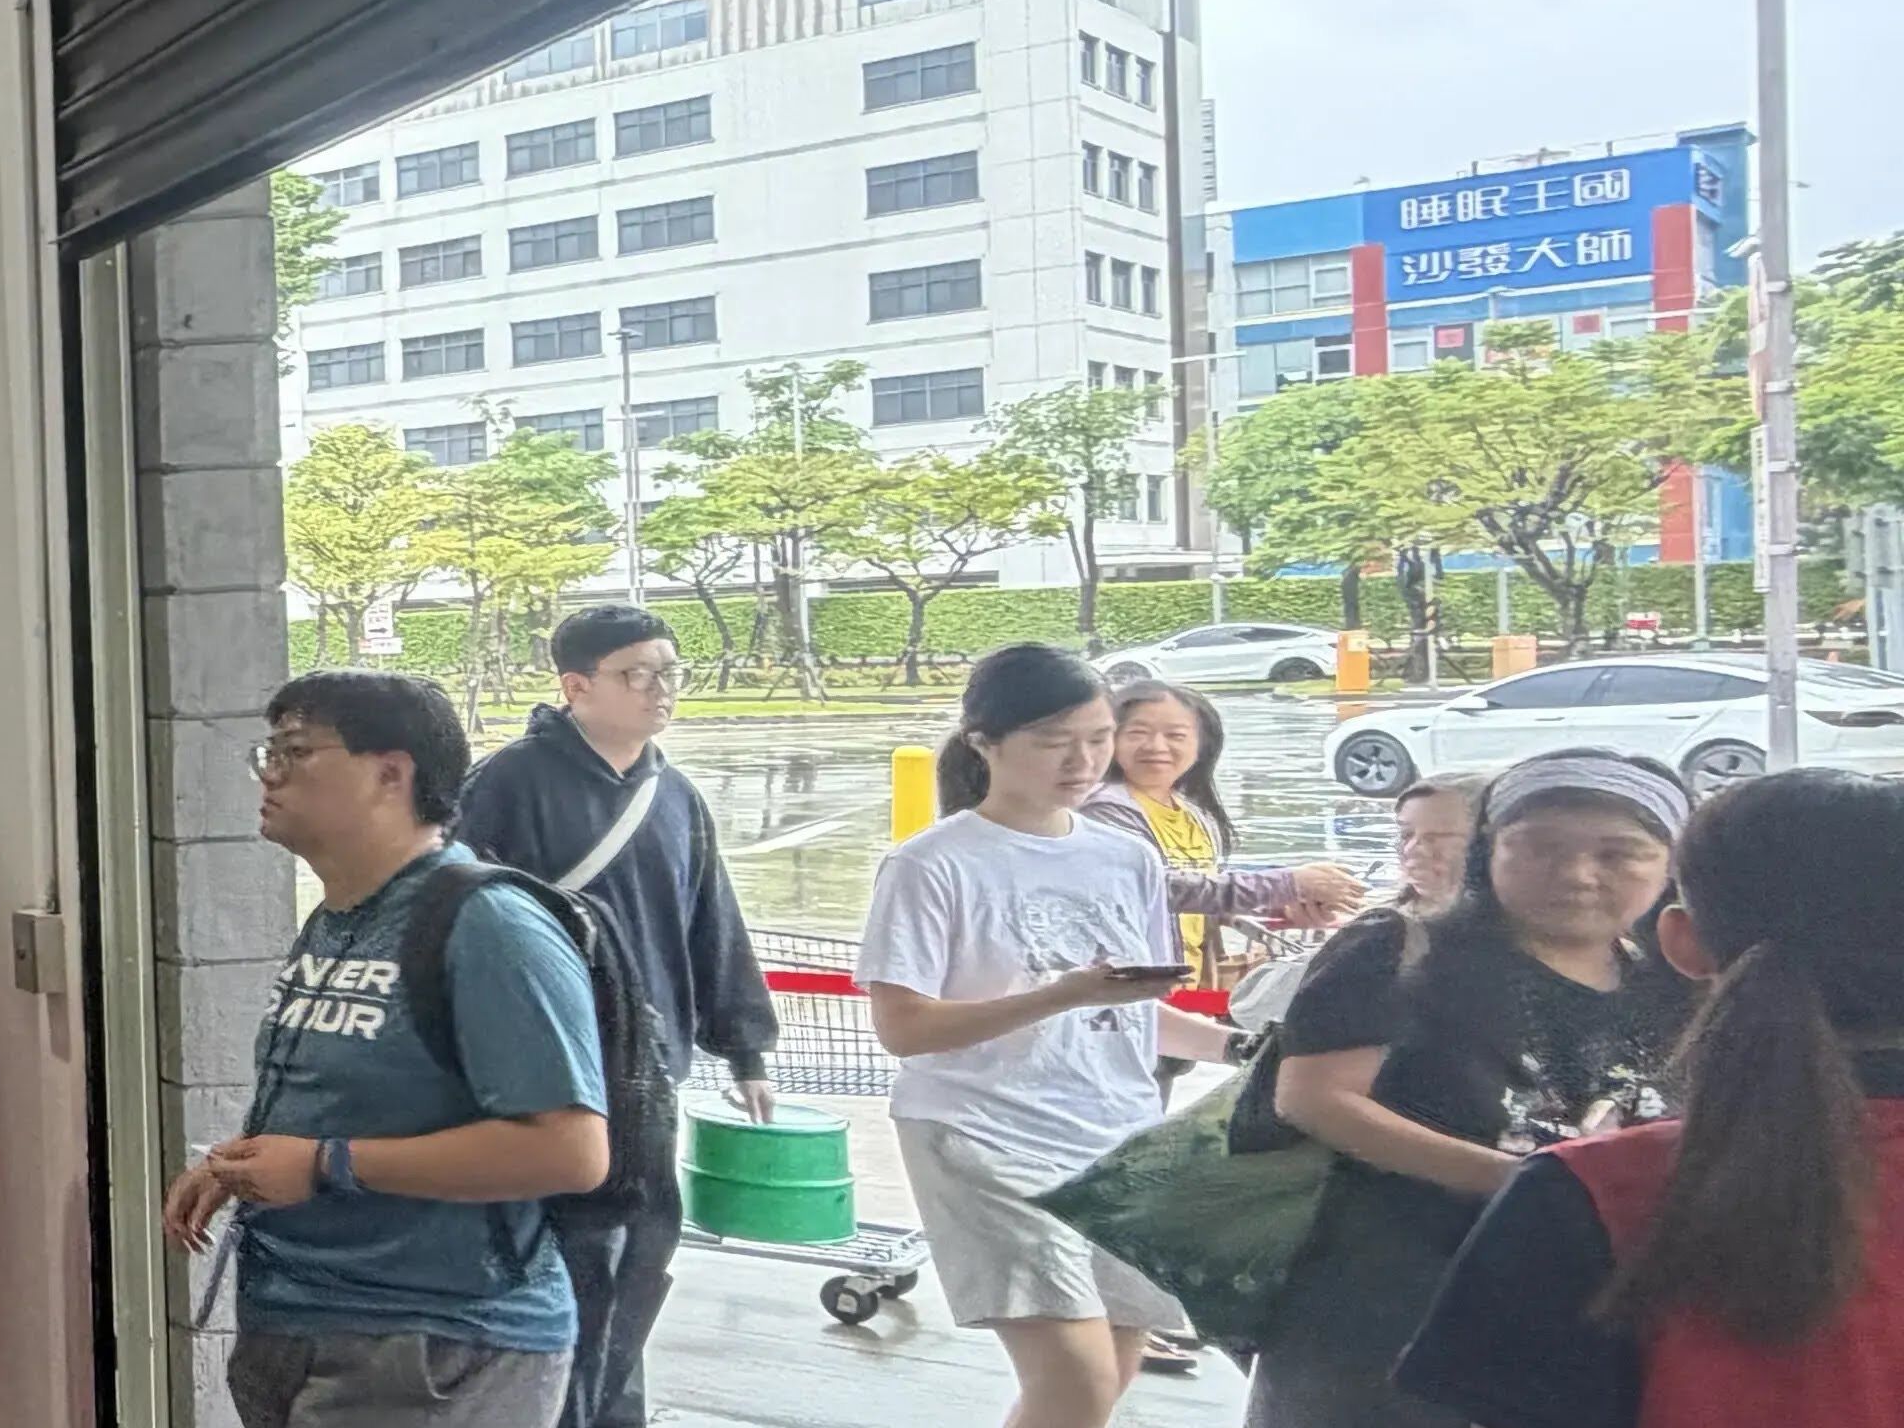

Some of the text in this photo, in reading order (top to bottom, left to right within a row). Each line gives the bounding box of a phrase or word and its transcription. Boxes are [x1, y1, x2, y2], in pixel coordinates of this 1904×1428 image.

[1400, 168, 1630, 230] 睡眠王國
[1401, 228, 1632, 286] 沙發大師
